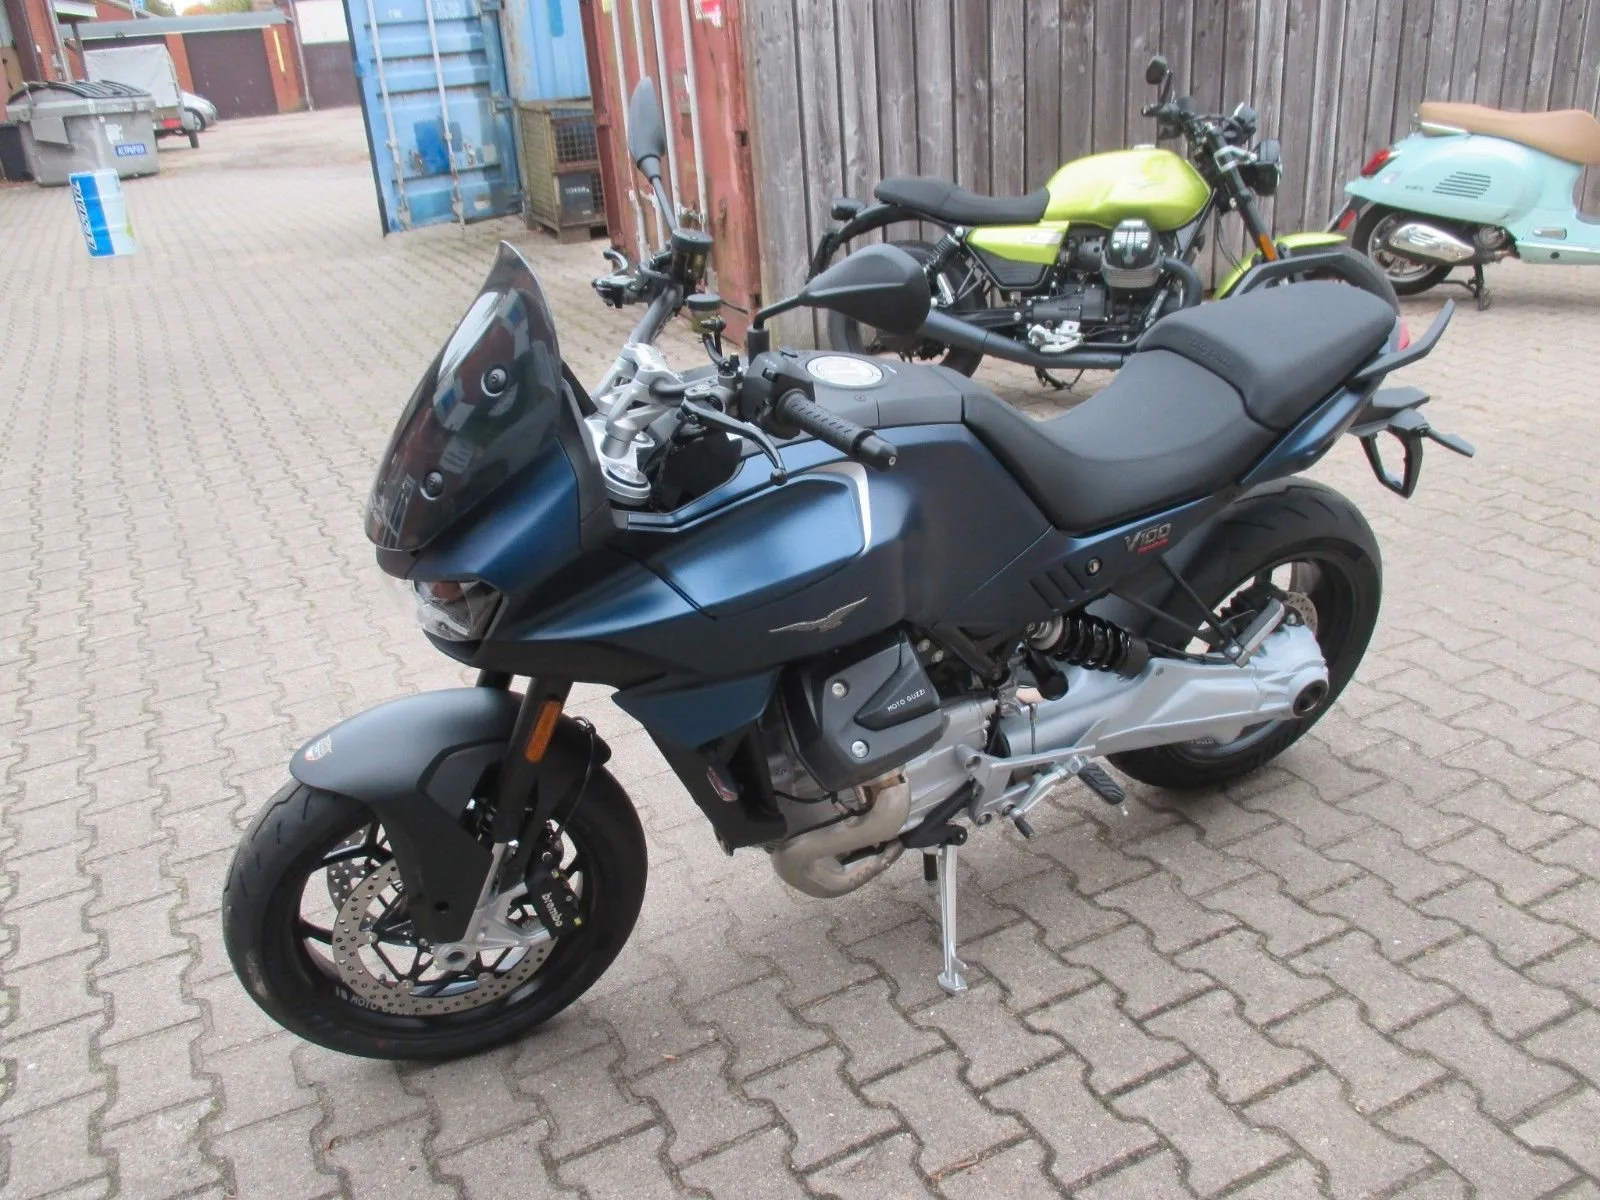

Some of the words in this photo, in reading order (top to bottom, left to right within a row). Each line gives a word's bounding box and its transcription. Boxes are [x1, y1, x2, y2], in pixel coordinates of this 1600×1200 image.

[1124, 523, 1171, 552] V100
[887, 699, 906, 712] MOTO
[906, 688, 926, 702] GUZZI
[541, 891, 563, 927] brembo
